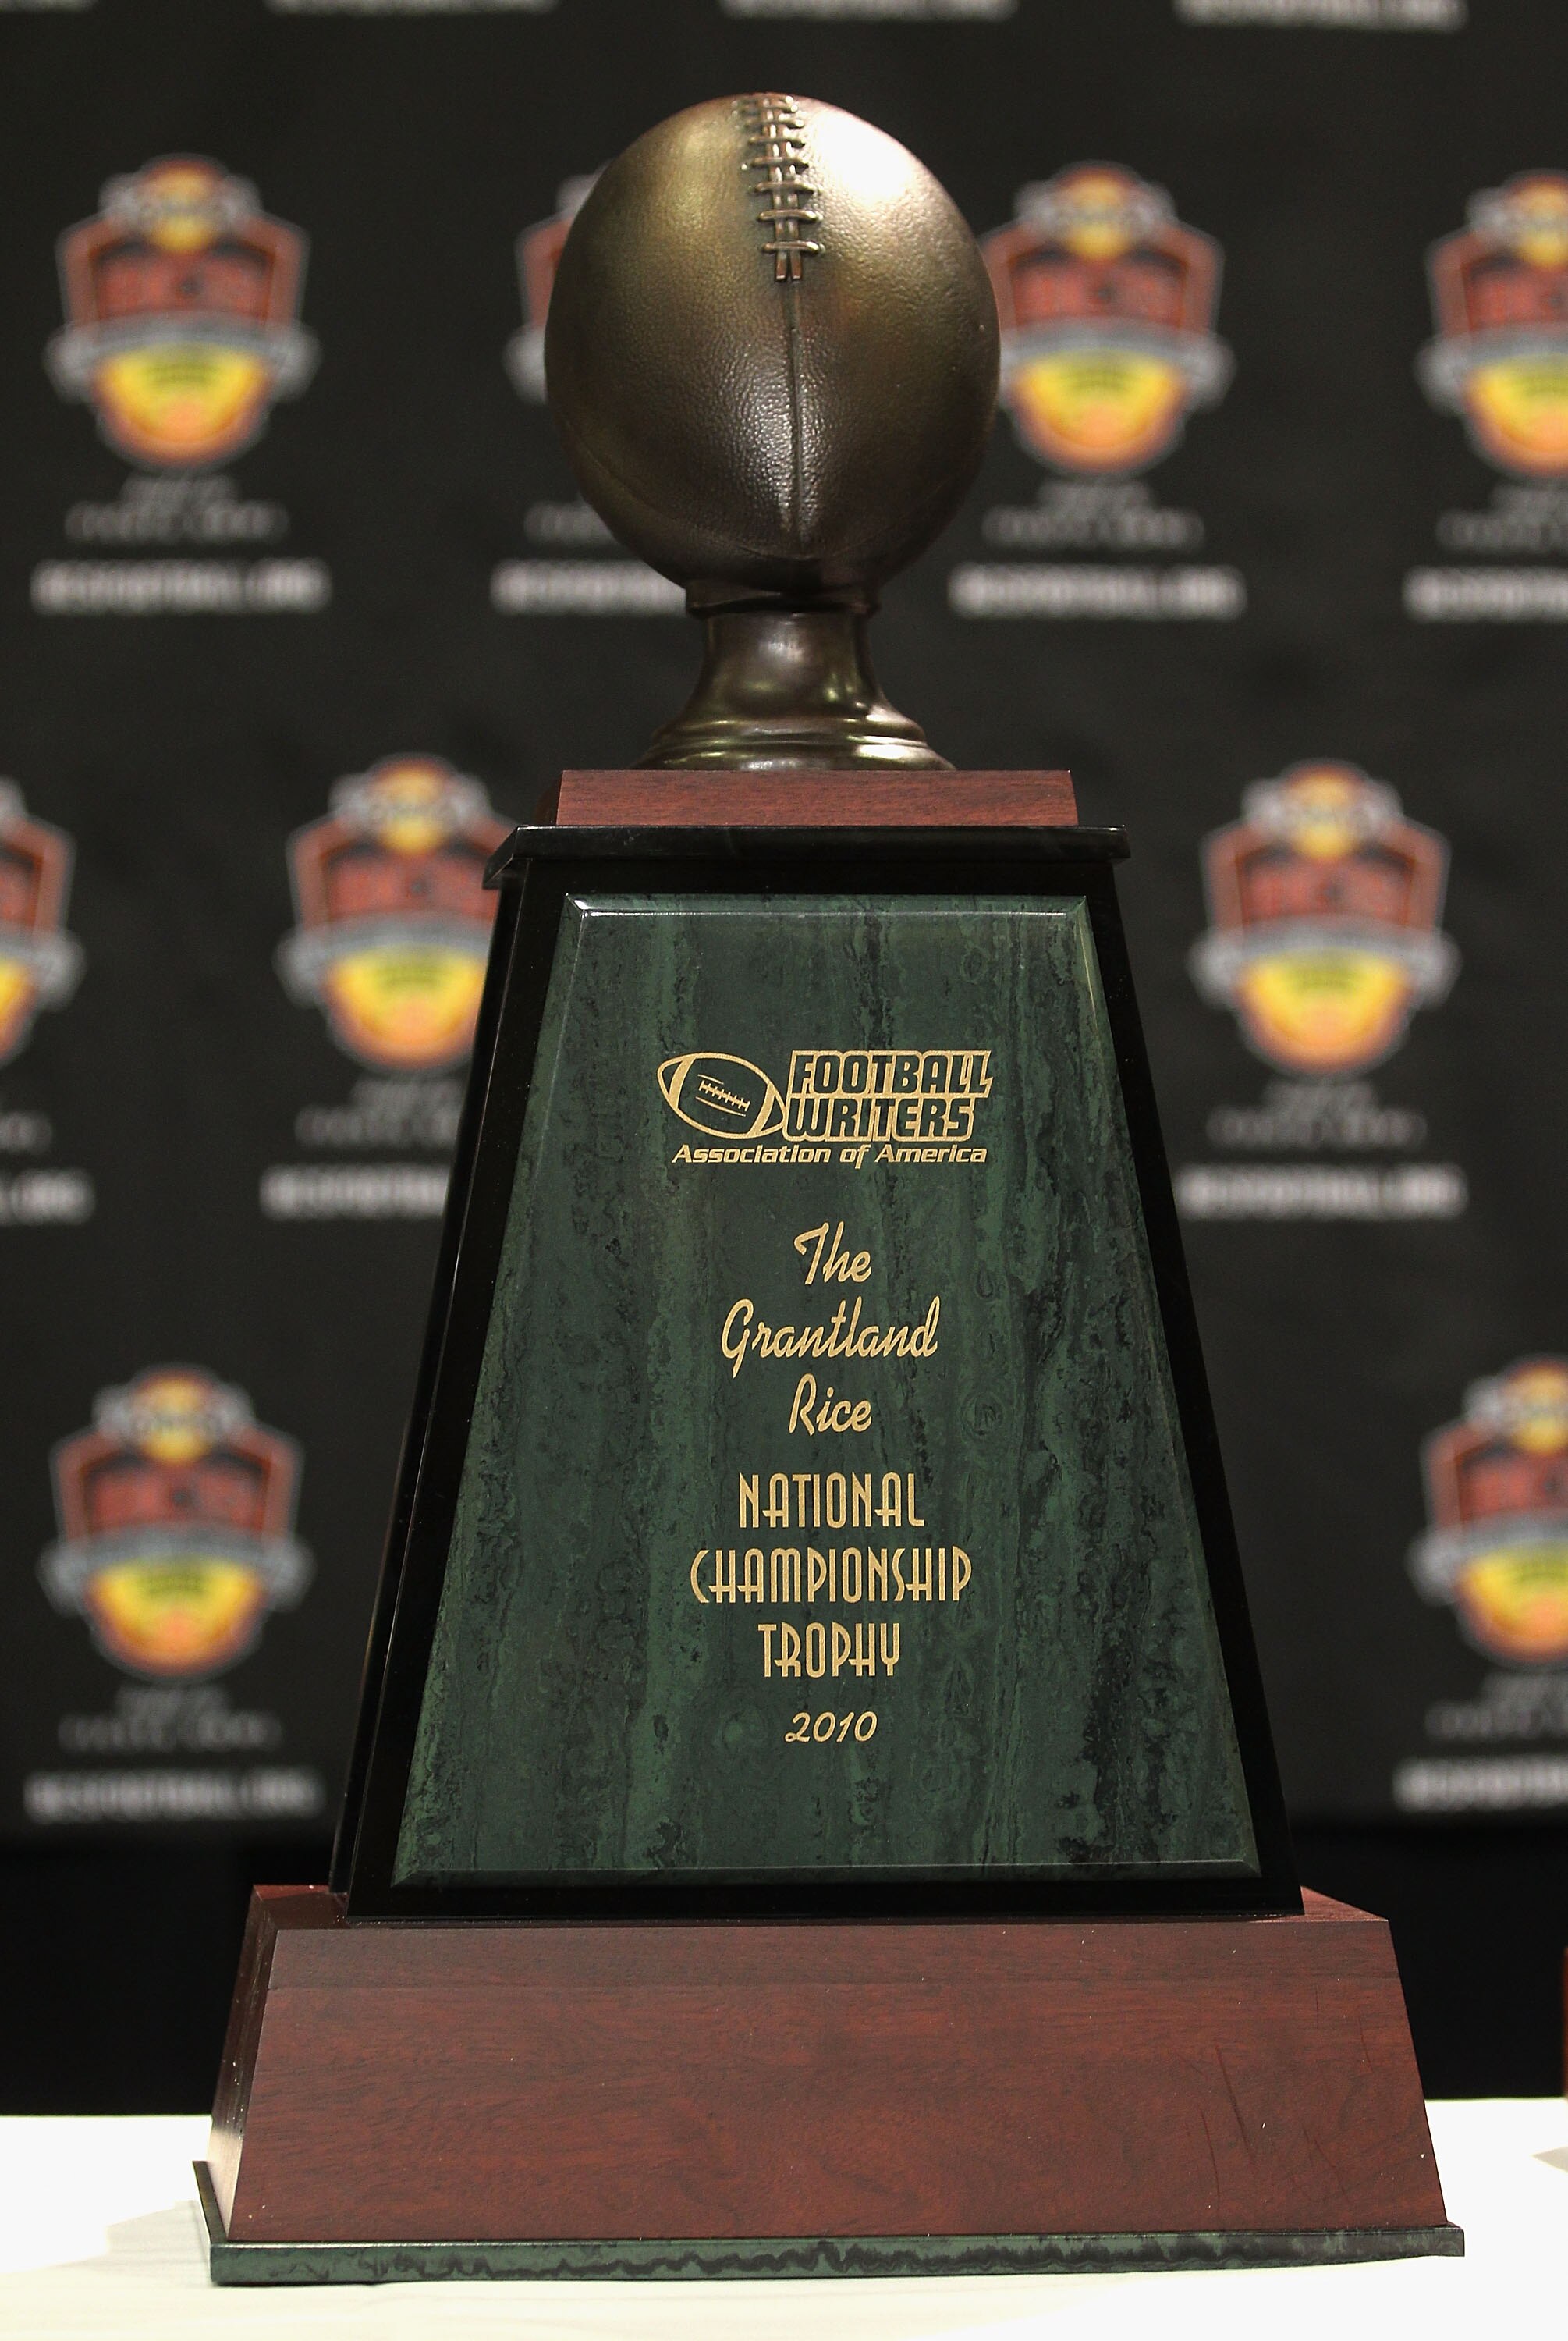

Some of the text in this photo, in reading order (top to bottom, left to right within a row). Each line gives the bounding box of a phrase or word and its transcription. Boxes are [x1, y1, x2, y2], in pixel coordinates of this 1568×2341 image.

[787, 1050, 994, 1098] FOOTBALL
[782, 1094, 976, 1142] WRITERS
[672, 1143, 988, 1170] Association of America
[793, 1220, 871, 1285] The
[721, 1295, 940, 1378] Grantland
[789, 1373, 872, 1437] Rice
[739, 1472, 925, 1529] NATIONAL
[690, 1545, 972, 1604] CHAMPIONSHIP
[757, 1621, 900, 1678] TROPHY
[784, 1710, 878, 1742] 2010
